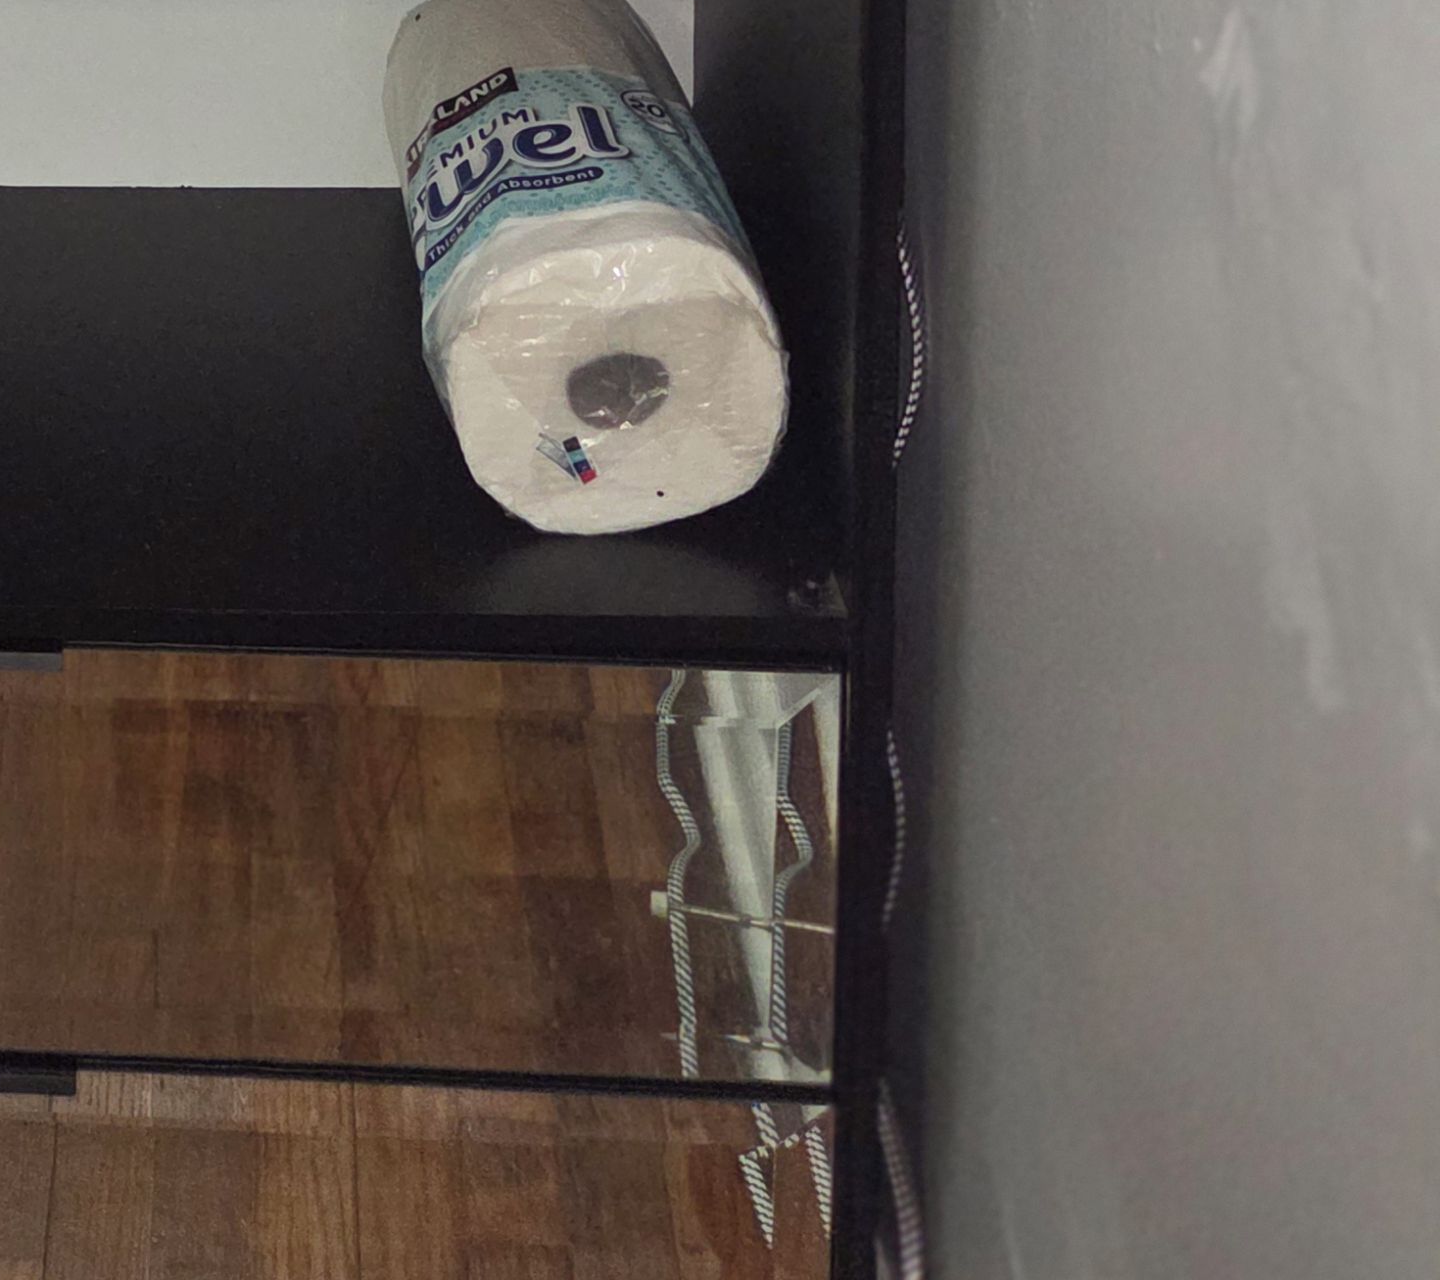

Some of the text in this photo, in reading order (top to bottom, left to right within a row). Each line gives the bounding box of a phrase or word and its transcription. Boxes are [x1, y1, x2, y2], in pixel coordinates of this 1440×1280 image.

[428, 222, 464, 262] Thick
[468, 192, 492, 222] and
[497, 169, 595, 194] Absorbent
